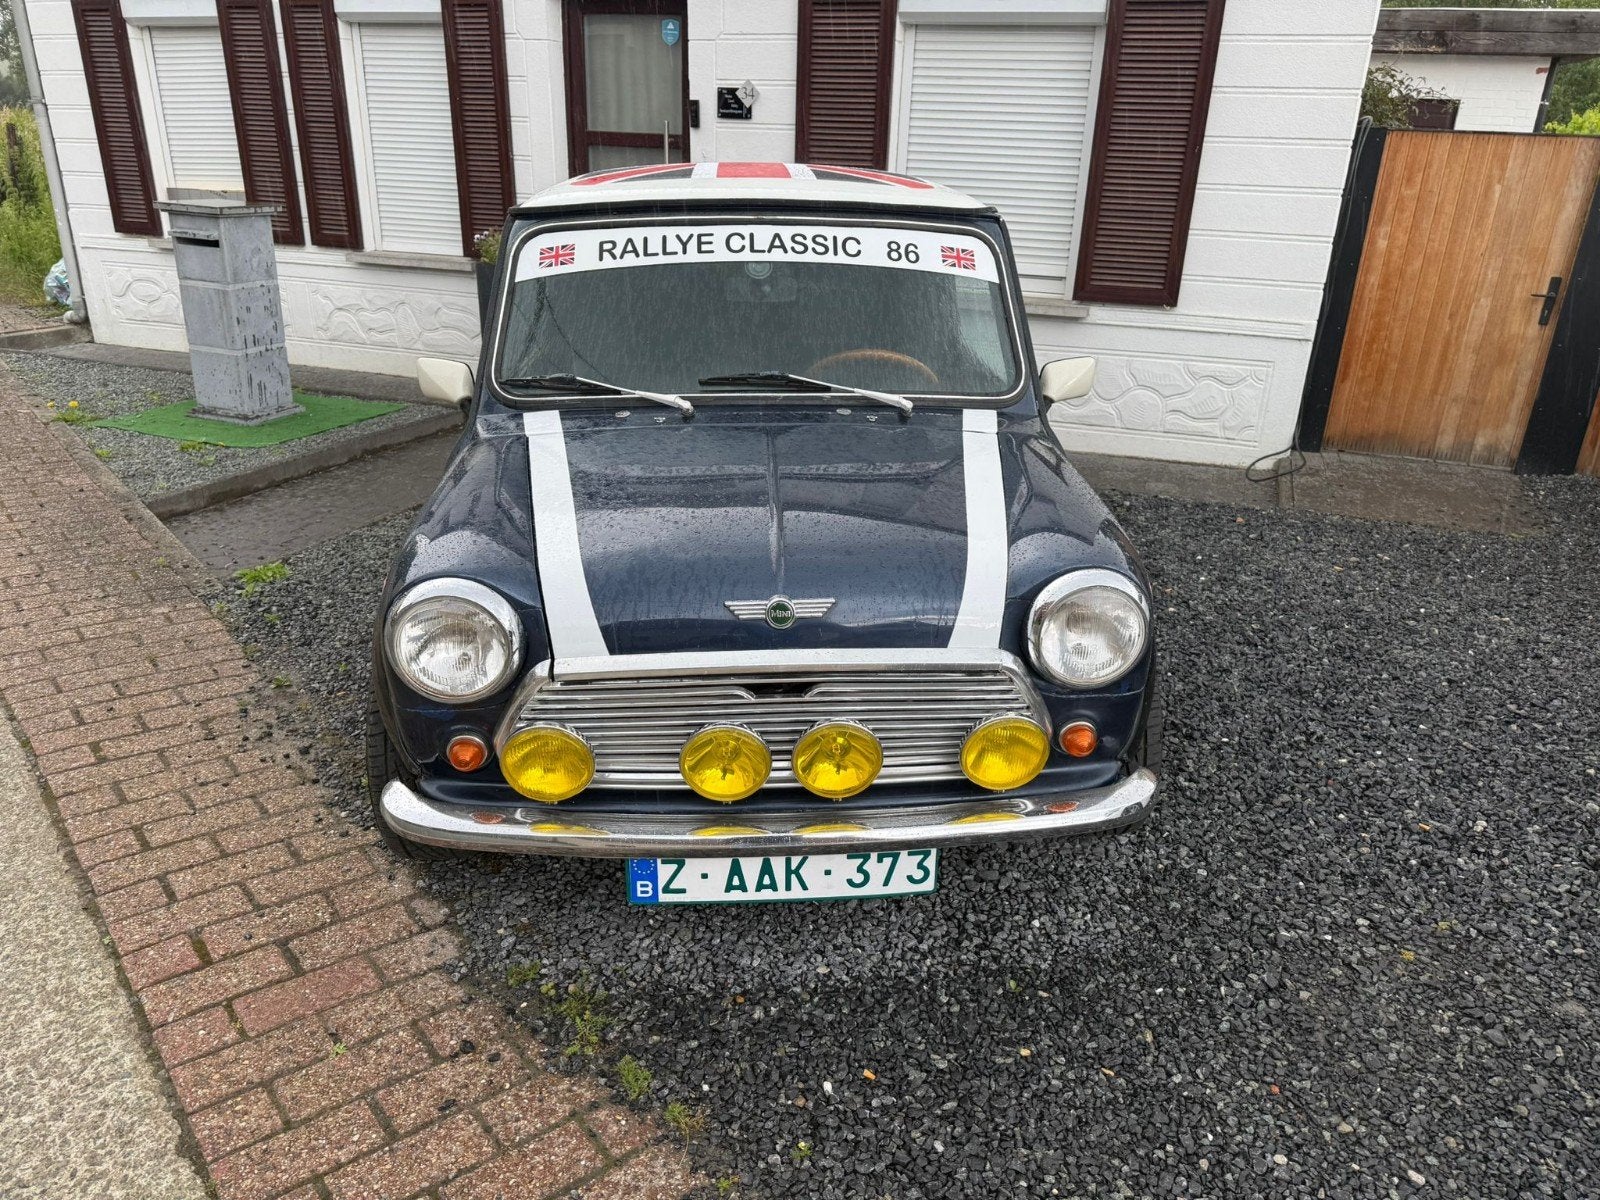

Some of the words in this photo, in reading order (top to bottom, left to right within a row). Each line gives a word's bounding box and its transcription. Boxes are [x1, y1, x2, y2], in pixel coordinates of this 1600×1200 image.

[741, 87, 755, 100] 34
[598, 232, 715, 262] RALLYE
[725, 232, 862, 258] CLASSIC
[886, 240, 920, 264] 86
[770, 609, 791, 618] MINI
[636, 880, 653, 897] B
